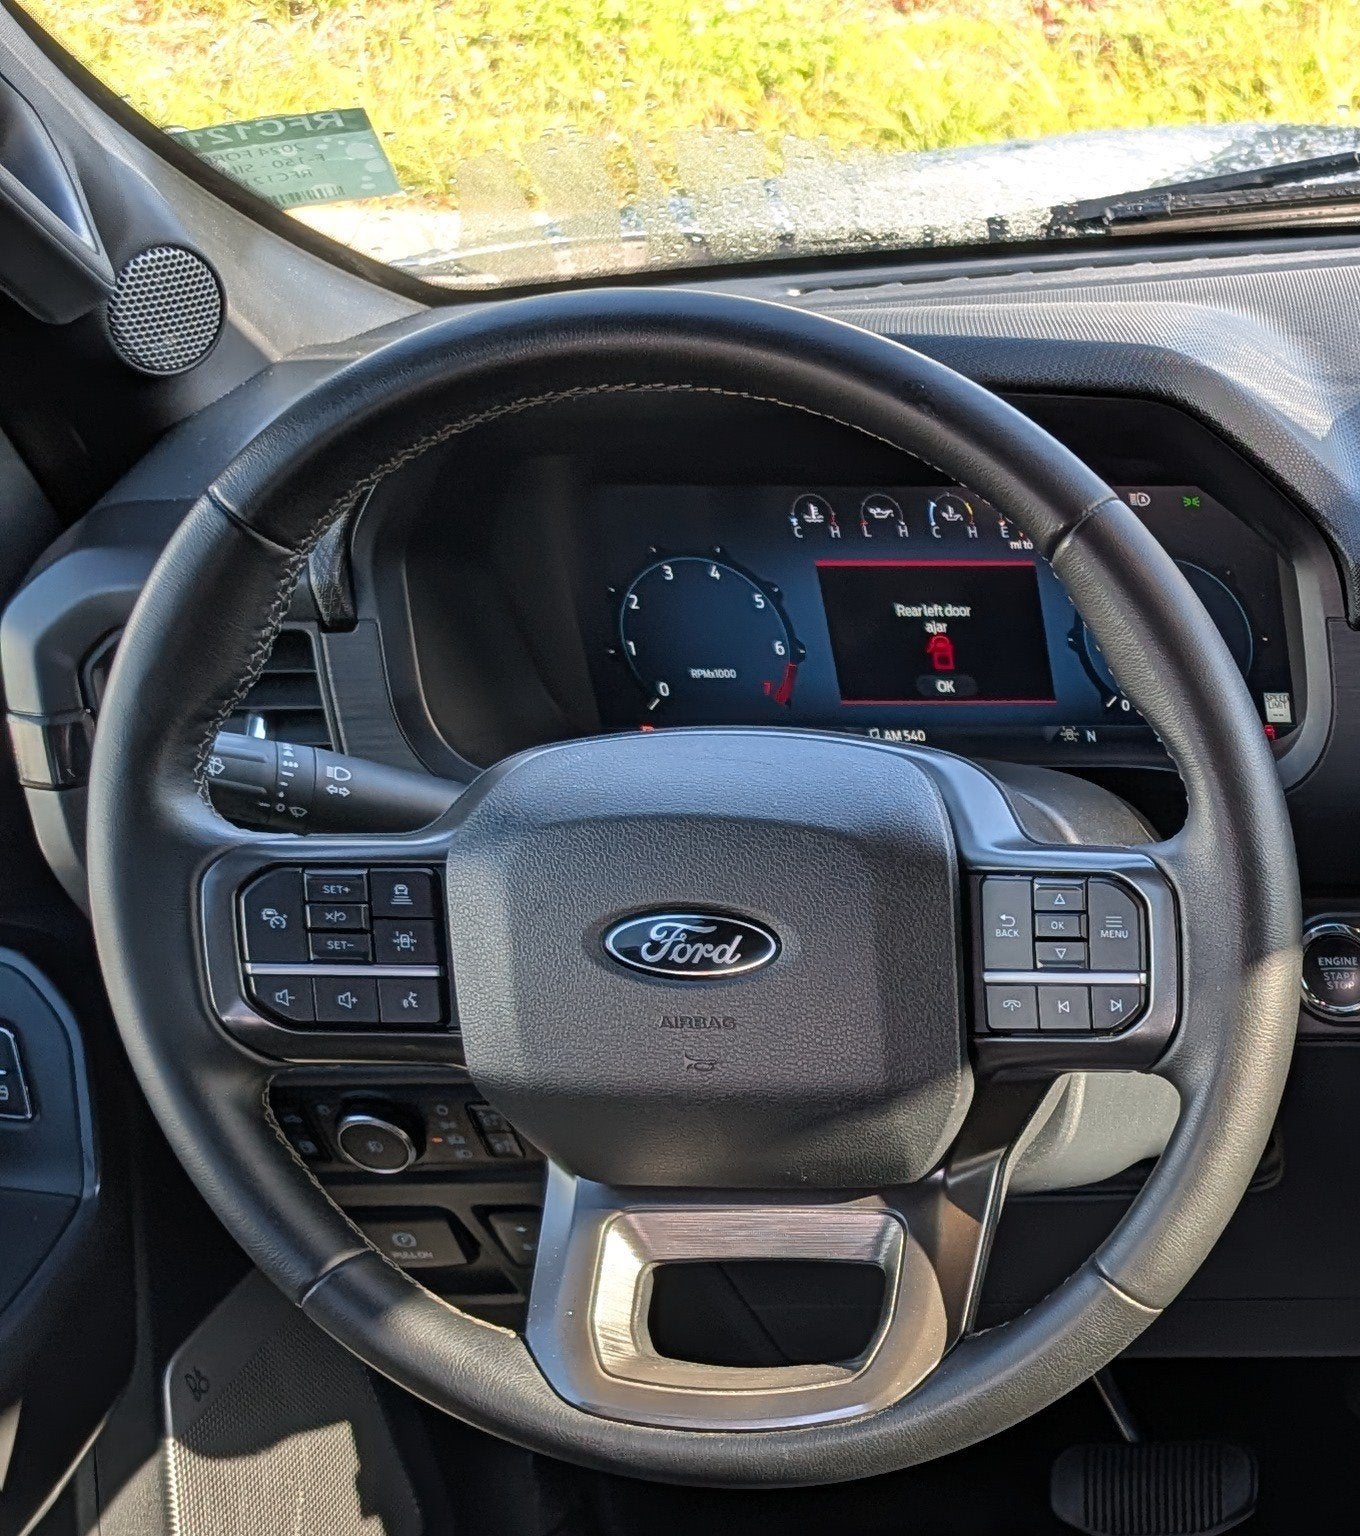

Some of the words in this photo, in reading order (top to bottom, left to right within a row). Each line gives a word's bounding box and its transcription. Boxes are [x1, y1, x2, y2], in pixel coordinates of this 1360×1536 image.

[662, 565, 674, 581] 3
[708, 565, 721, 581] 4
[628, 594, 640, 610] 2
[753, 593, 765, 609] 5
[895, 602, 921, 617] Rear
[922, 602, 944, 617] left
[944, 602, 971, 617] door
[924, 619, 947, 635] ajar
[625, 641, 636, 656] 1
[773, 640, 785, 656] 6
[657, 681, 670, 697] 0
[935, 680, 955, 693] OK
[1120, 699, 1131, 711] 0
[883, 729, 902, 742] AM
[903, 729, 926, 742] 540
[1086, 731, 1097, 743] N
[1051, 921, 1065, 930] OK
[995, 929, 1020, 938] BACK
[1100, 929, 1129, 939] MENU
[640, 921, 743, 965] Ford
[1317, 956, 1359, 966] ENGINE
[1323, 971, 1357, 981] START
[1326, 981, 1355, 990] STOP
[660, 1015, 737, 1030] AIRBAG
